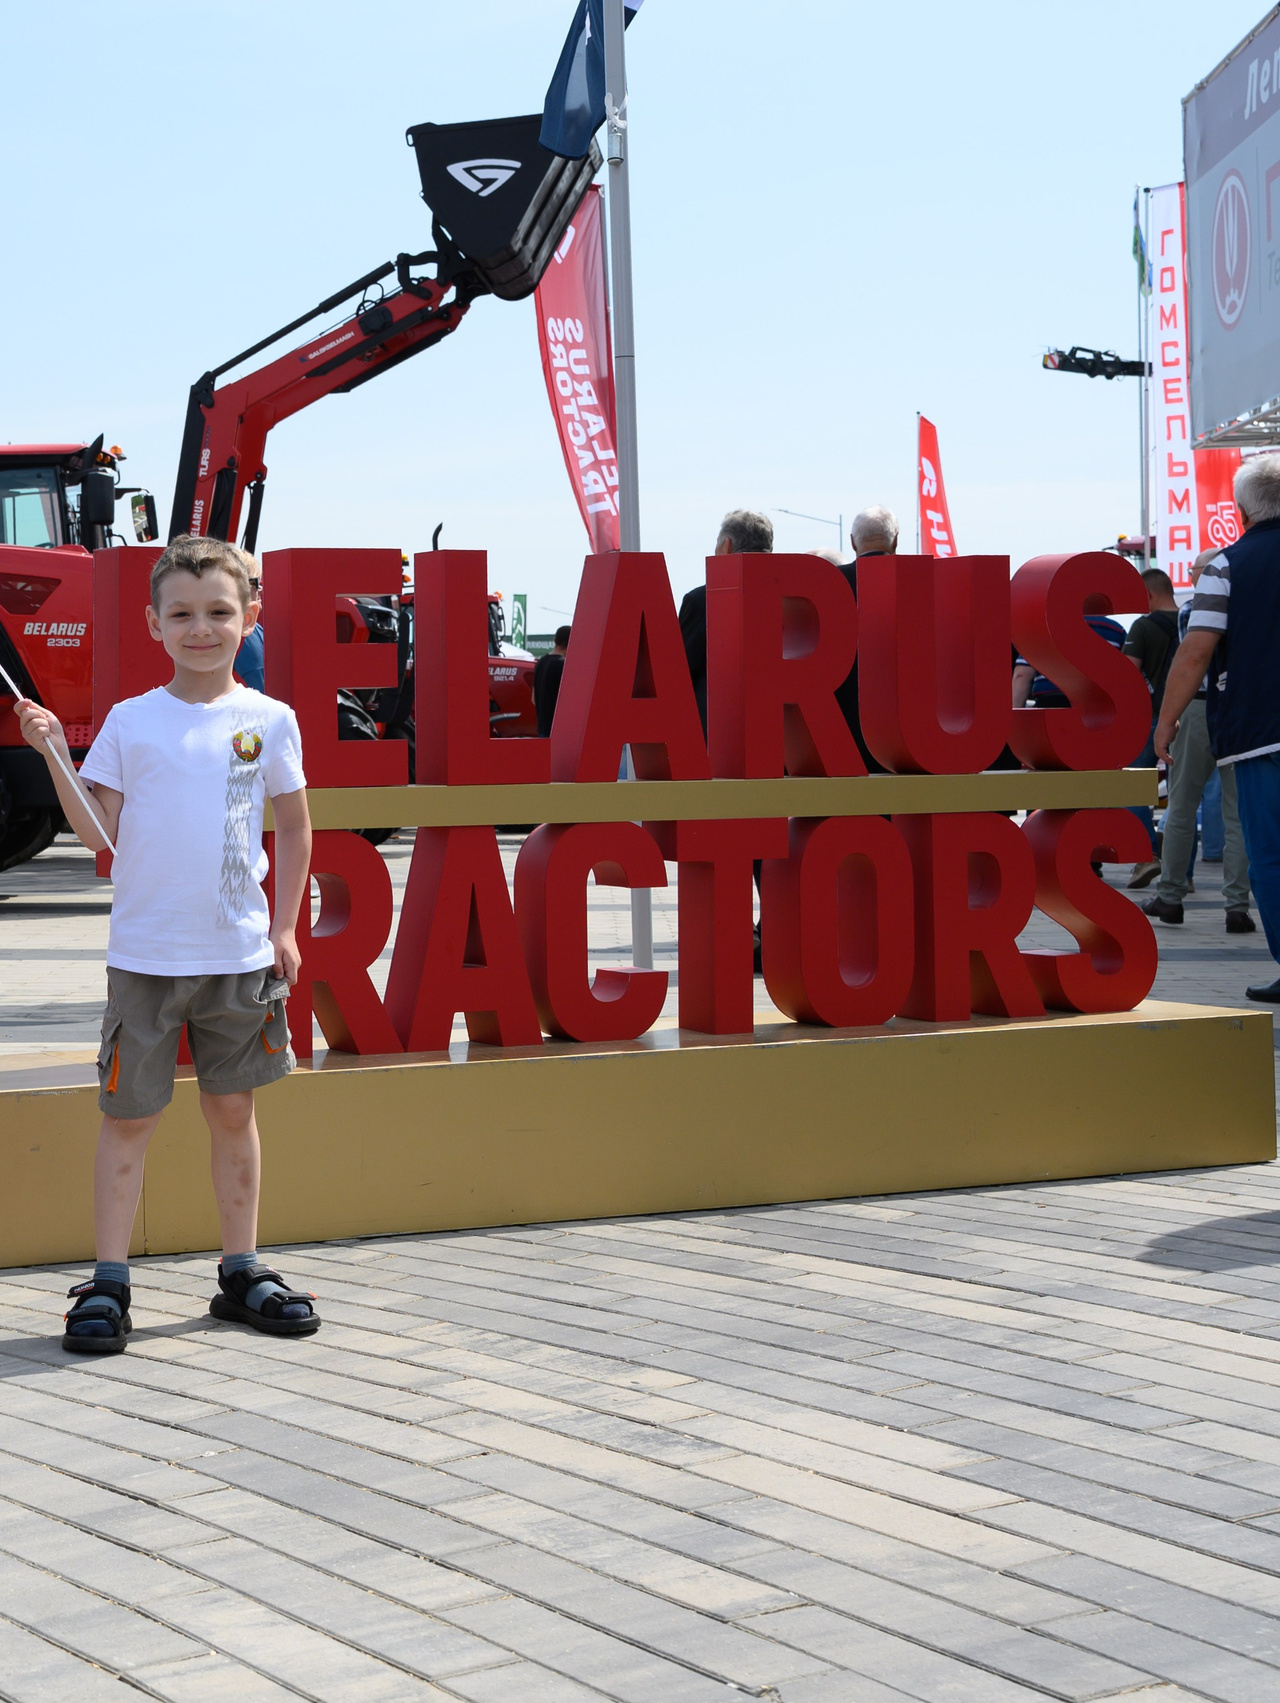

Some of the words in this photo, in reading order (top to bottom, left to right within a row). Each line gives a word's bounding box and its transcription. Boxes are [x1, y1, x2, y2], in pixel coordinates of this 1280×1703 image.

[199, 448, 211, 477] TURS
[23, 622, 87, 636] BELARUS
[47, 638, 81, 647] 2303
[96, 808, 1159, 1067] RACTORS
